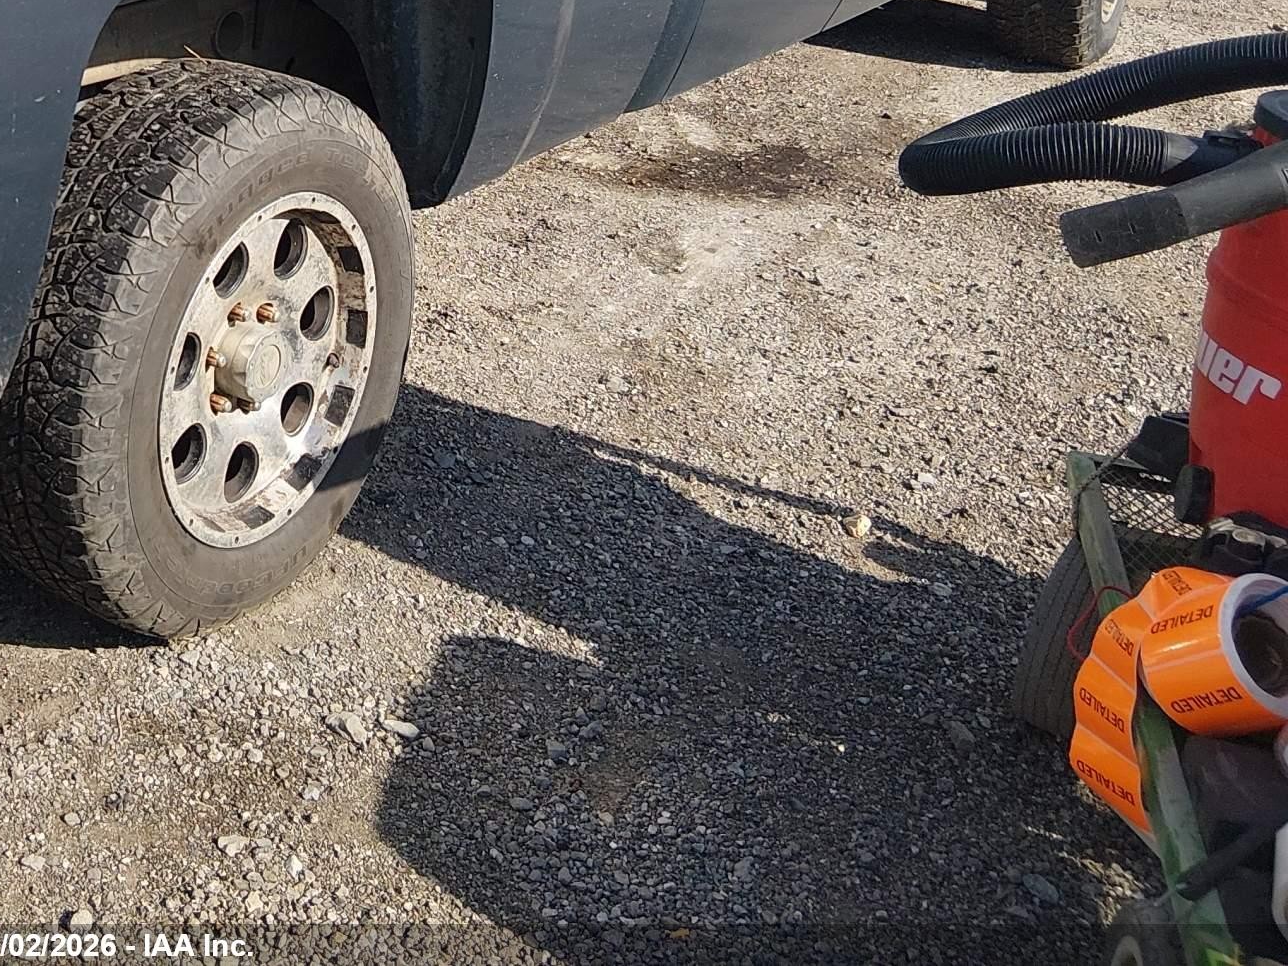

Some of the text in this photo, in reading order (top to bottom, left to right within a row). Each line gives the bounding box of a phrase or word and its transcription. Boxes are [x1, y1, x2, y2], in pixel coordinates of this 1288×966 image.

[1150, 605, 1214, 635] DETAILED
[1078, 686, 1125, 734] DETAILED
[1168, 686, 1244, 714] DETAILED
[1075, 759, 1137, 807] DETAILED
